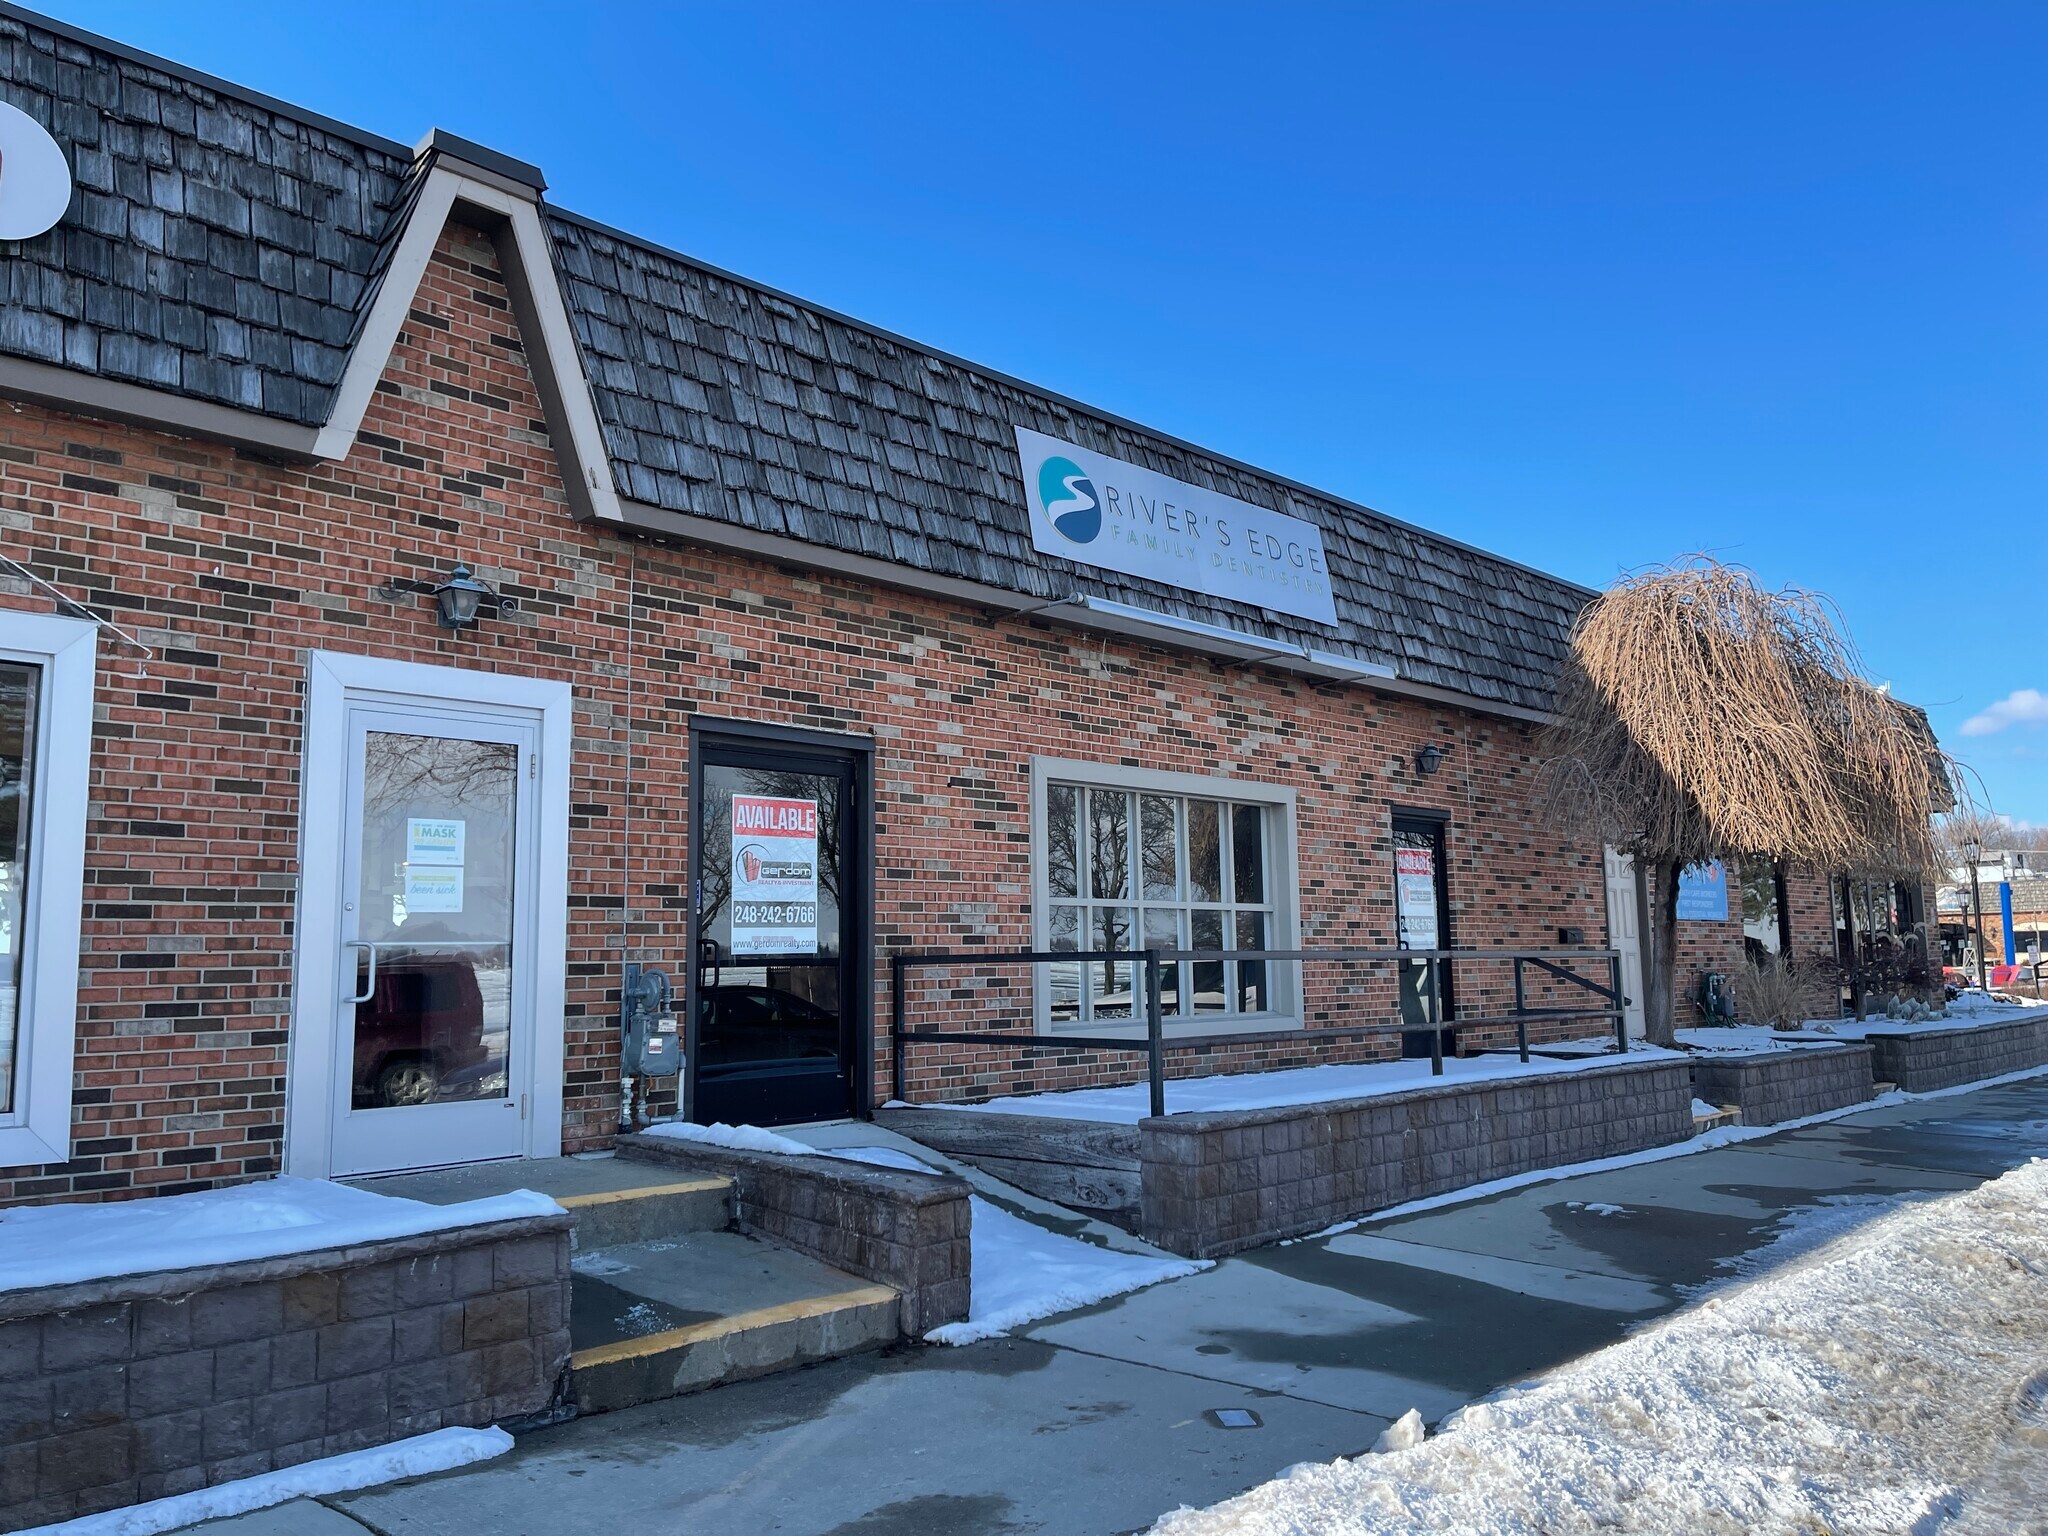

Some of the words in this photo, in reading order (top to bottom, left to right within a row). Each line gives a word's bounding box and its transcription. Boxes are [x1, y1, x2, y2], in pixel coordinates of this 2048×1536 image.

[1104, 485, 1231, 547] RIVER'S
[1246, 528, 1322, 574] EDGE
[1112, 525, 1196, 560] FAMILY
[1211, 552, 1325, 596] DENTISTRY
[736, 804, 815, 831] AVAILABLE
[421, 828, 457, 838] MASK
[410, 883, 434, 895] been
[435, 883, 456, 895] sick
[735, 905, 815, 924] 248-242-6766
